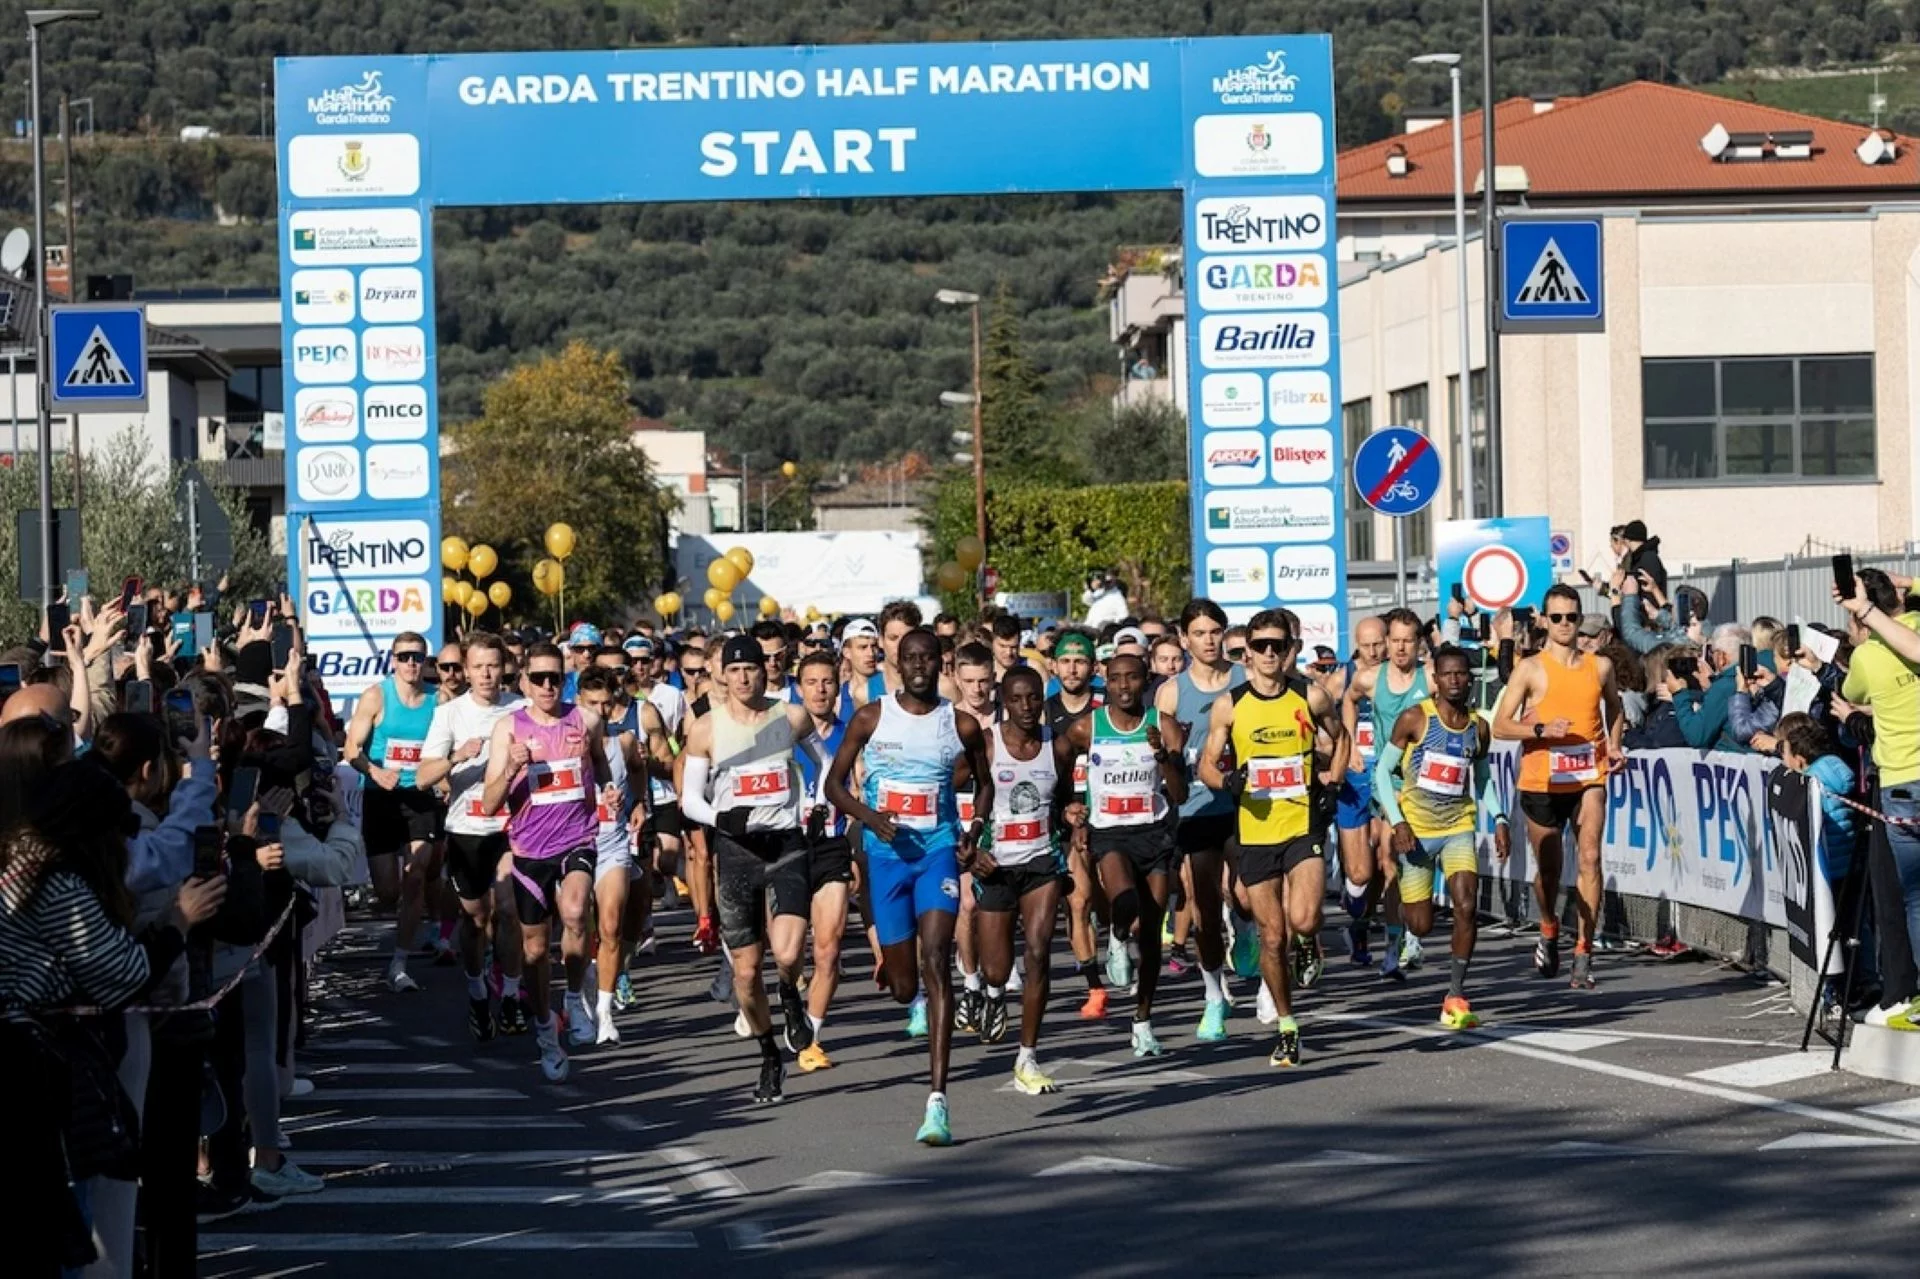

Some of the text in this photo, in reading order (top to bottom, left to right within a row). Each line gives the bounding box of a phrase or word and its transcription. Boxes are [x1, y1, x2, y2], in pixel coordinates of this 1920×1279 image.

[459, 61, 1149, 105] GARDA TRENTINO HALF MARATHON
[700, 128, 916, 177] START
[1202, 212, 1321, 244] TRENTINO
[1206, 262, 1320, 290] GARDA
[365, 287, 417, 303] Dryarn
[1236, 292, 1294, 302] TRENTINO
[1214, 323, 1315, 351] Barilla
[297, 344, 349, 365] PEJO
[1273, 389, 1328, 404] FibrXL
[367, 404, 423, 418] mico
[1274, 447, 1326, 465] Blistex
[308, 537, 424, 569] TRENTINO
[1278, 565, 1330, 581] Dryarn
[308, 588, 424, 615] GARDA
[319, 649, 395, 676] Baril
[553, 772, 561, 786] 6
[1267, 770, 1286, 784] 14
[1440, 767, 1450, 779] 4
[751, 775, 770, 790] 24
[902, 796, 912, 811] 2
[1121, 799, 1128, 811] 1
[1606, 757, 1677, 872] PEJO
[1019, 825, 1028, 836] 3
